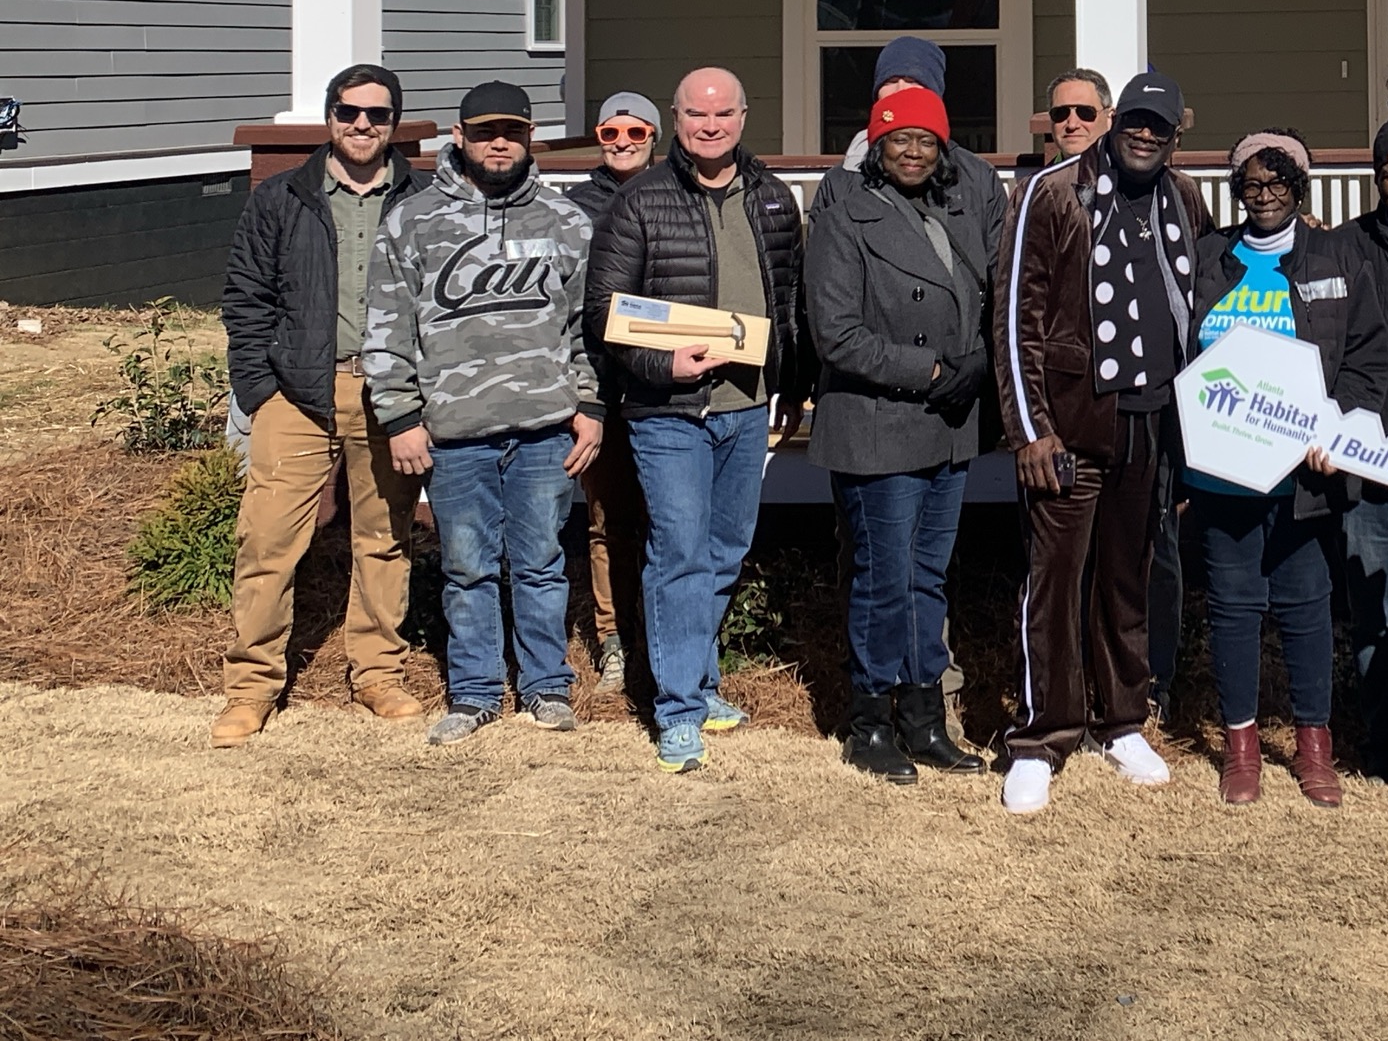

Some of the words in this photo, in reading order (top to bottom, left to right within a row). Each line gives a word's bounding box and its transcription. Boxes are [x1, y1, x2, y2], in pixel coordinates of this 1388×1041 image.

[1212, 284, 1293, 313] utur
[1256, 380, 1285, 396] Atlanta
[1245, 413, 1261, 426] for
[1249, 392, 1319, 431] Habitat
[1329, 433, 1343, 452] I
